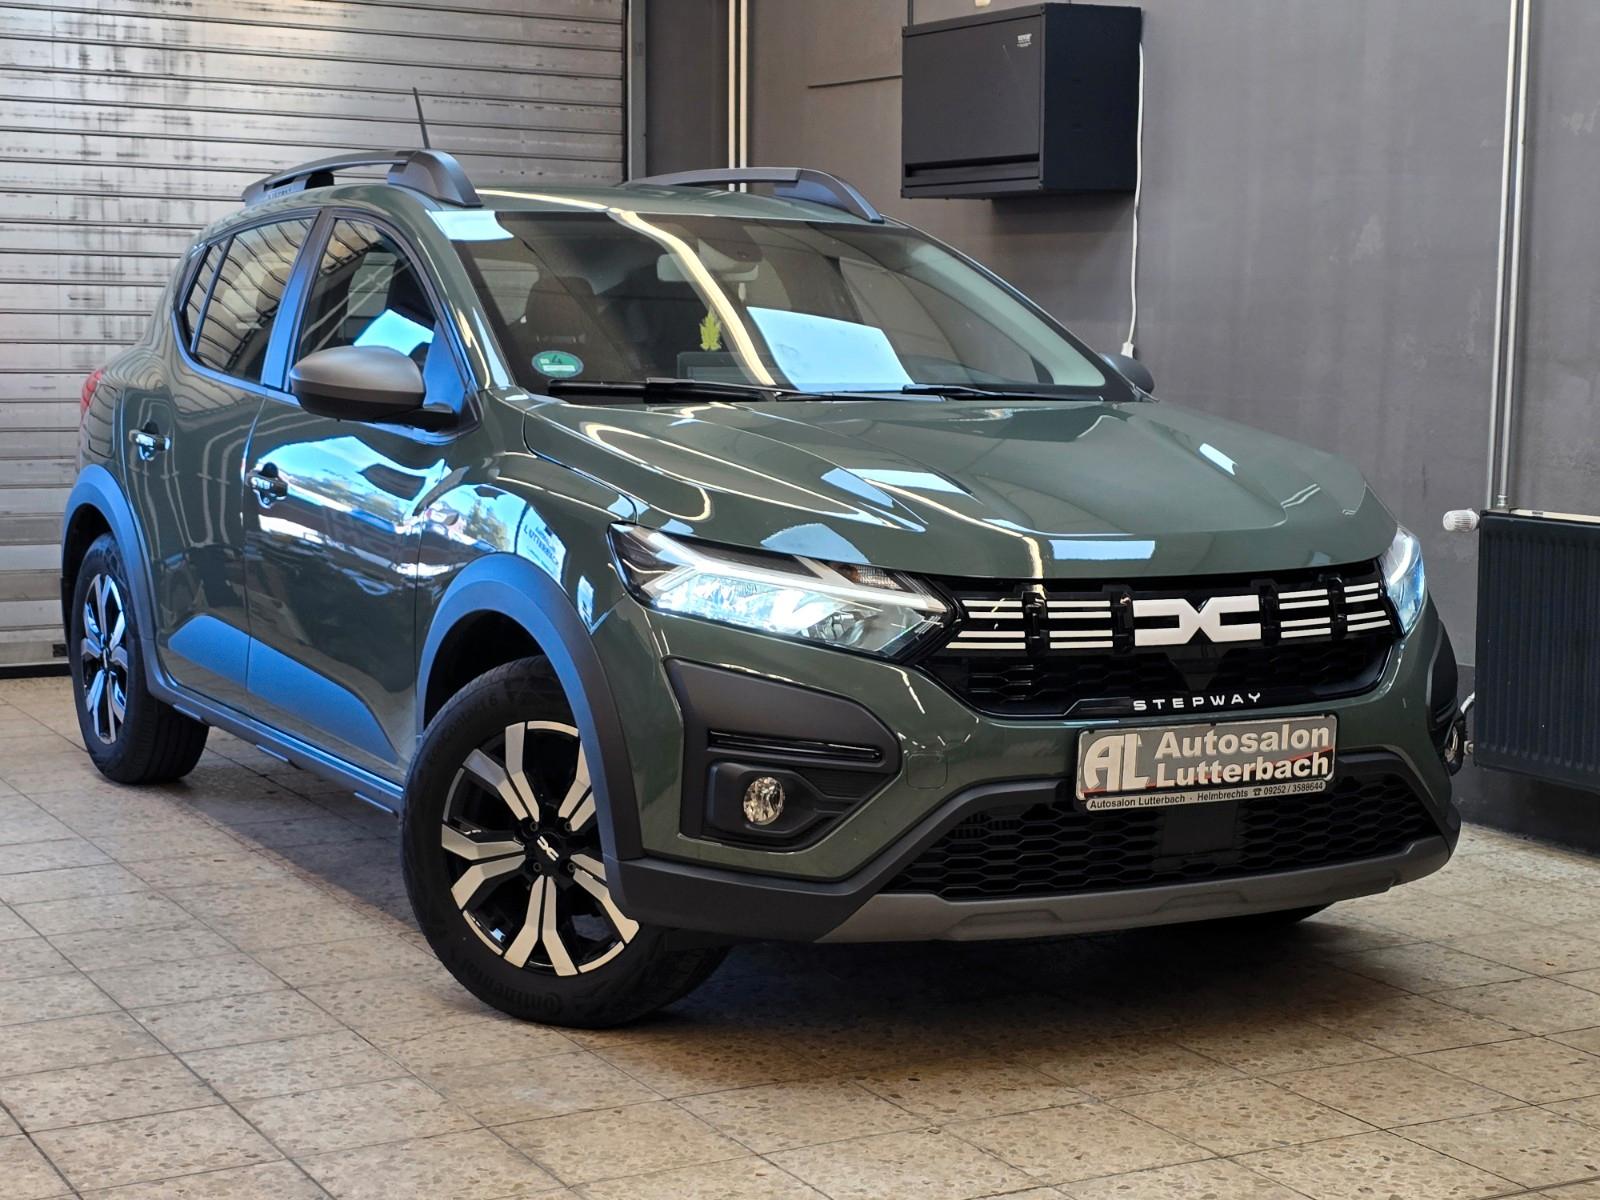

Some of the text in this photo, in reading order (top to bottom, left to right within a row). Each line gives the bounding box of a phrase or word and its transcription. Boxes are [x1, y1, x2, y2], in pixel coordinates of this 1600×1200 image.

[1133, 692, 1261, 711] STEPWAY
[1154, 723, 1330, 760] Autosalon
[1156, 751, 1329, 788] Lutterbach
[1090, 798, 1136, 809] Autosalon
[1139, 794, 1185, 806] Lutterbach
[1197, 789, 1248, 802] Helmbrechts
